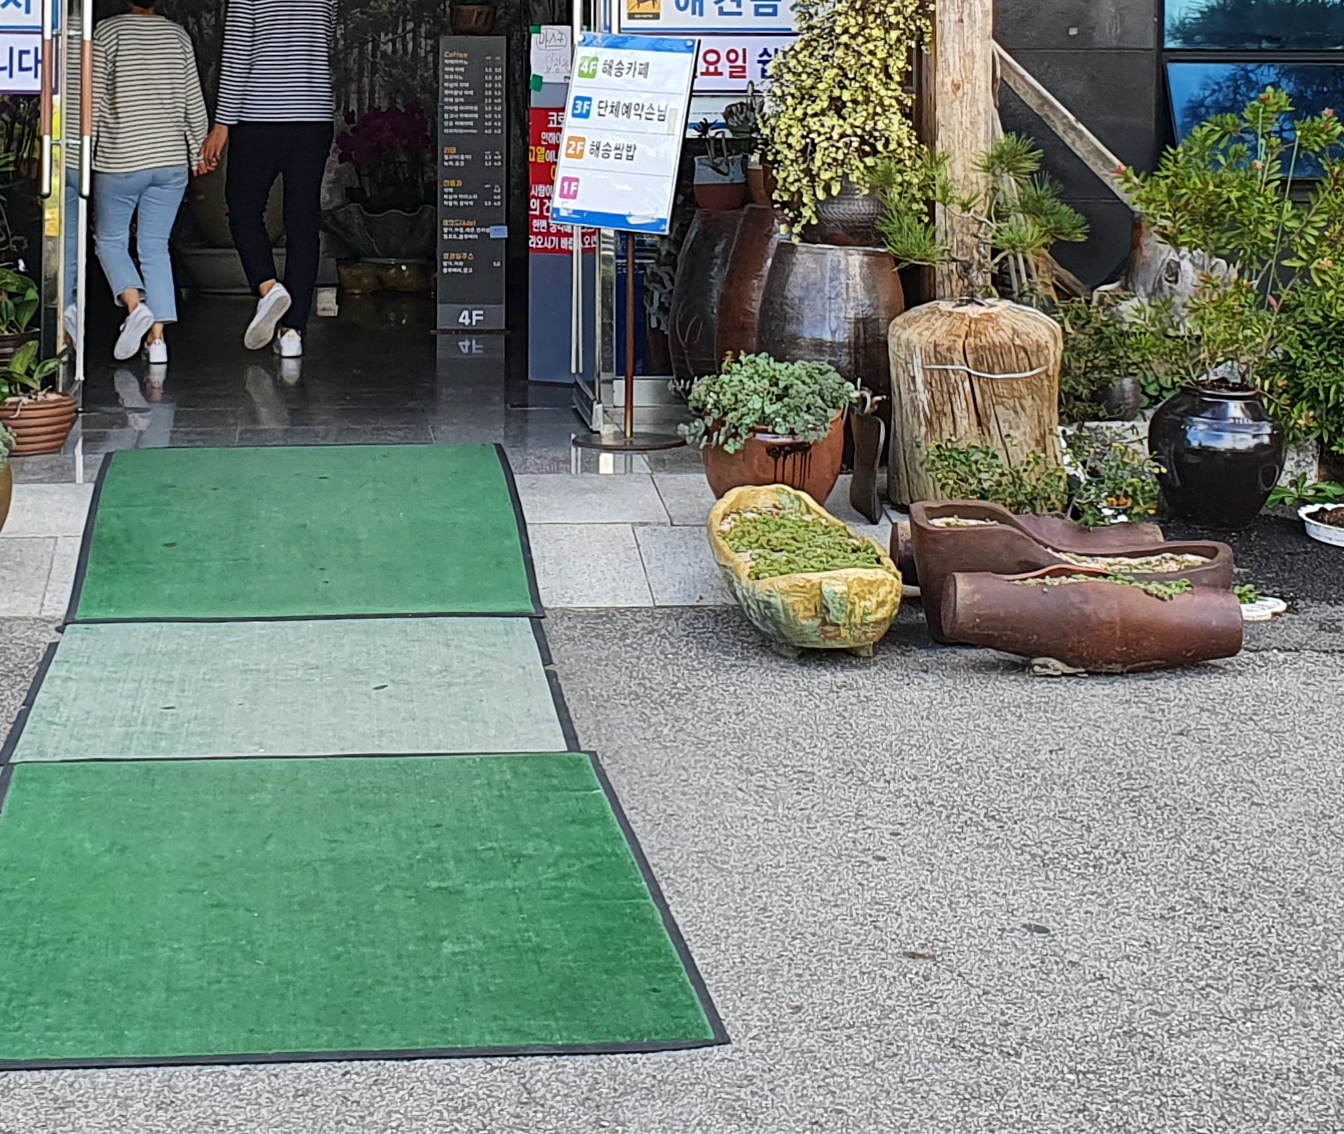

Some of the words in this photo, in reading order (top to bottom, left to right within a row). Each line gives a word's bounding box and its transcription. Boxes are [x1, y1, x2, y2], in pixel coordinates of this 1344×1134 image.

[580, 60, 597, 74] 4F
[601, 59, 651, 79] 해송카페
[699, 47, 747, 79] 요일
[573, 100, 591, 114] 3F
[596, 99, 668, 122] 단체예약손님
[567, 139, 585, 154] 2F
[588, 140, 637, 161] 해송쌈밥
[562, 181, 578, 196] 1F
[458, 309, 484, 326] 4F
